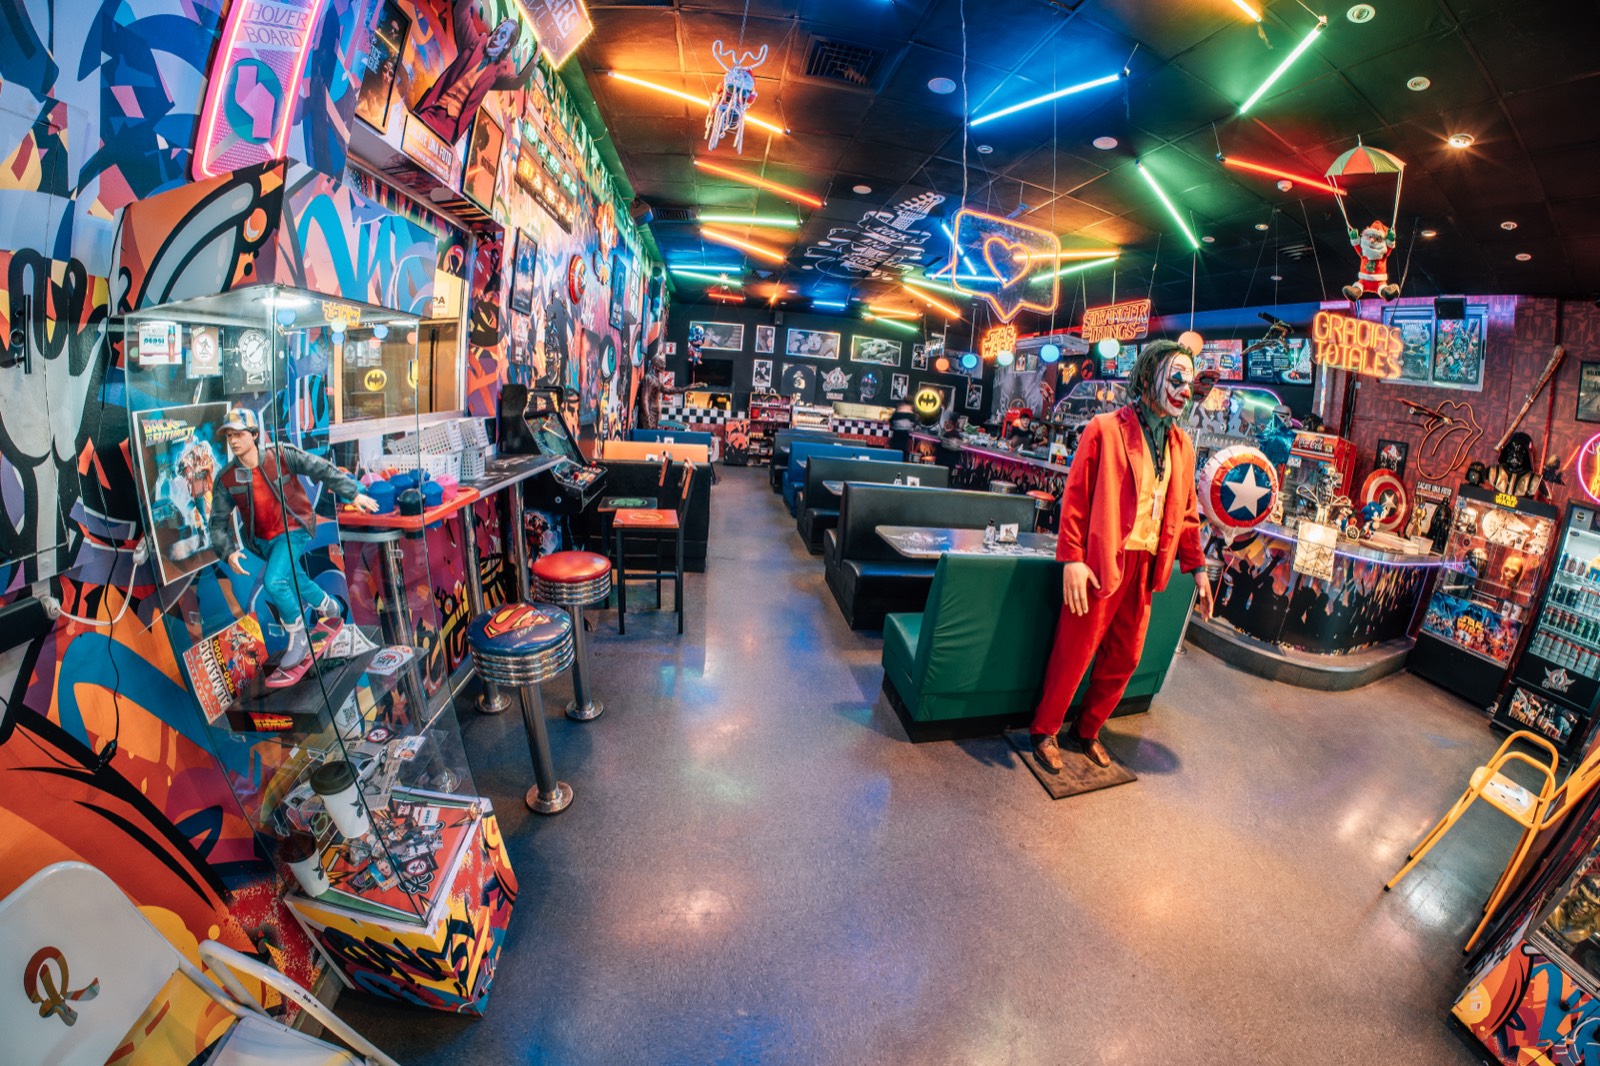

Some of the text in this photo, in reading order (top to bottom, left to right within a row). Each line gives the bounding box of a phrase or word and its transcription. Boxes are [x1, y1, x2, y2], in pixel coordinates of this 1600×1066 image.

[247, 3, 309, 28] HOVER
[244, 26, 303, 48] BOARD
[872, 225, 912, 241] ROCK
[1083, 303, 1149, 331] STRANGER
[988, 325, 1015, 341] STAR
[1314, 311, 1403, 351] GRACIAS
[1315, 339, 1402, 379] TOTALES
[1496, 493, 1517, 502] STAR
[1458, 615, 1484, 631] STAR
[191, 645, 221, 715] SPORTS
[200, 640, 230, 706] ALMANAC
